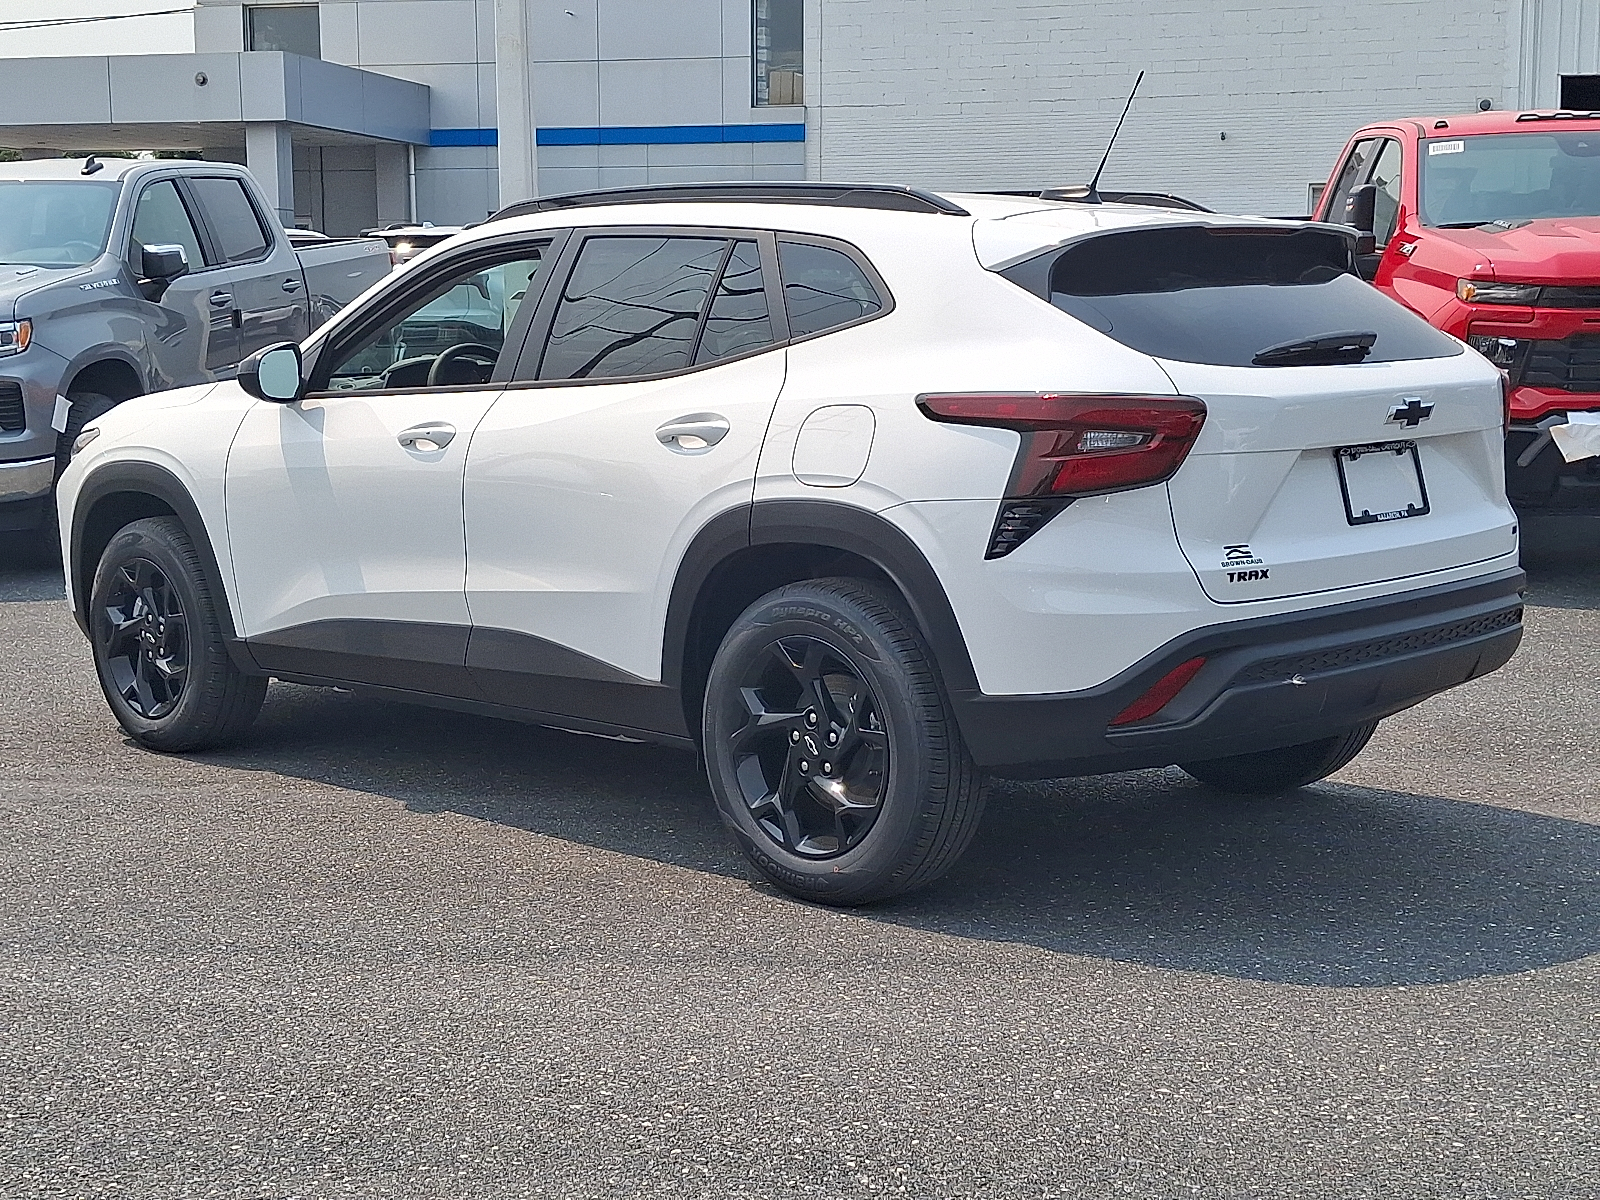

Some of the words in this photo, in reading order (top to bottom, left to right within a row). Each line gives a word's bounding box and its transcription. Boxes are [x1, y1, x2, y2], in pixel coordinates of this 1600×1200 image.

[1226, 568, 1270, 583] TRAX
[771, 606, 831, 621] Dynapro
[833, 618, 863, 645] HP2
